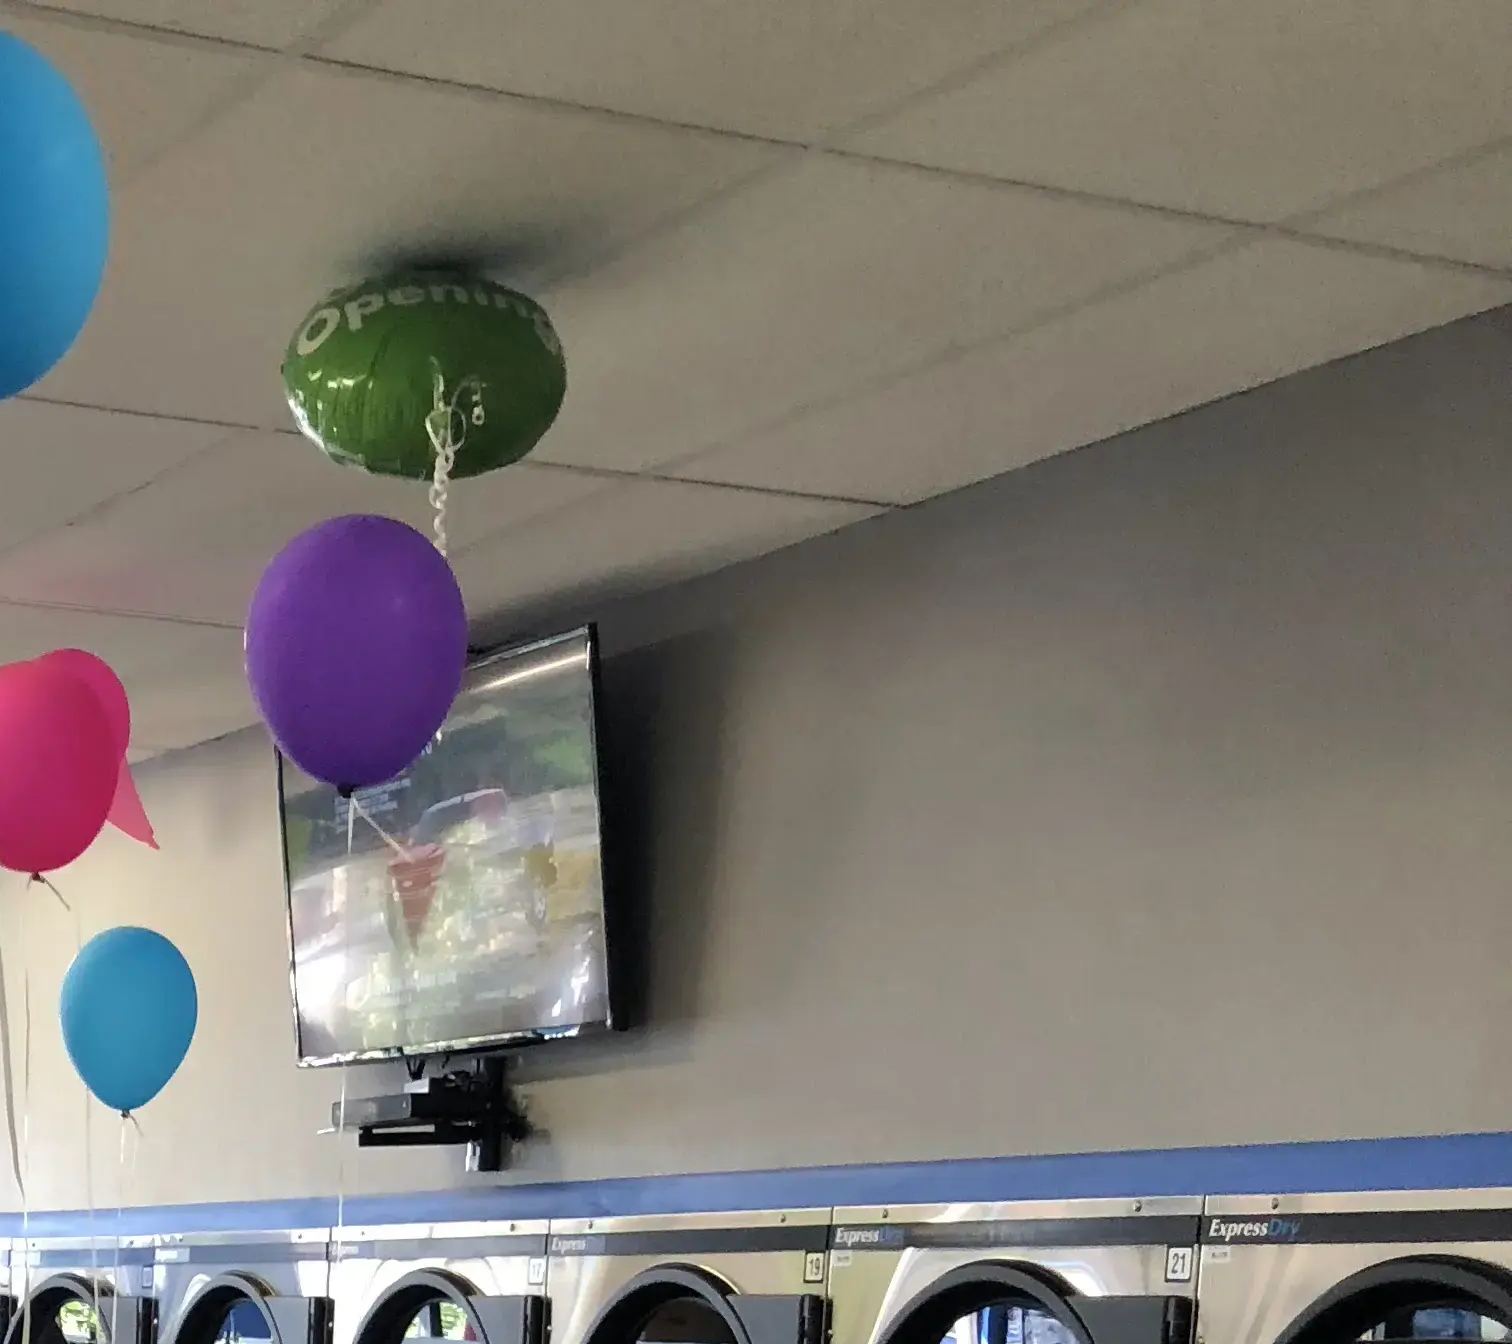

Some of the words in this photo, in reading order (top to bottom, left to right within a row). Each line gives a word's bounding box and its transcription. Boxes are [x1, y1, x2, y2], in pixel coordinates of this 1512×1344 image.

[296, 284, 565, 356] Opening
[808, 1257, 821, 1276] 19
[1171, 1252, 1186, 1274] 21
